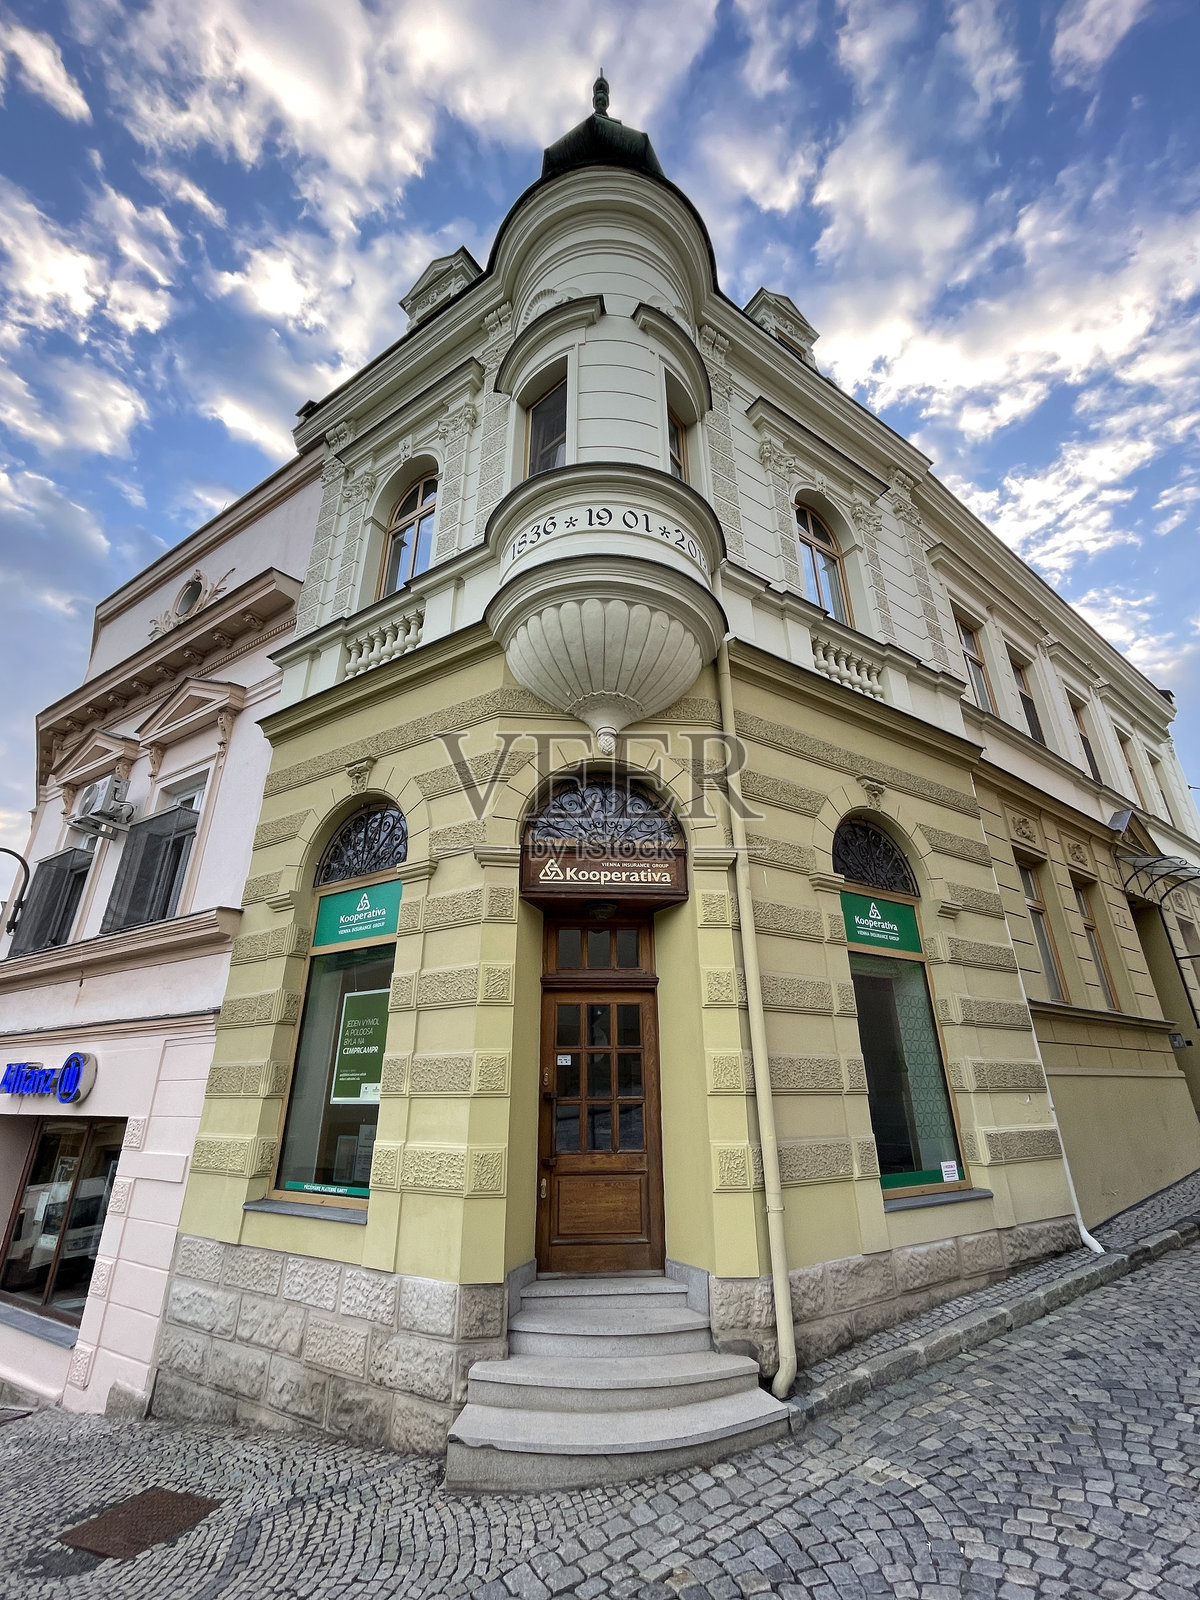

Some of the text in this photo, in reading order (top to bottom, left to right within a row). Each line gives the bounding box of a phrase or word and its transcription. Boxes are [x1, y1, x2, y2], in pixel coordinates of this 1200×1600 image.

[510, 516, 558, 560] 1836
[566, 867, 672, 886] Kooperativa
[340, 908, 386, 923] Kooperativa
[854, 916, 898, 931] Kooperativa
[0, 1063, 56, 1094] Allianz
